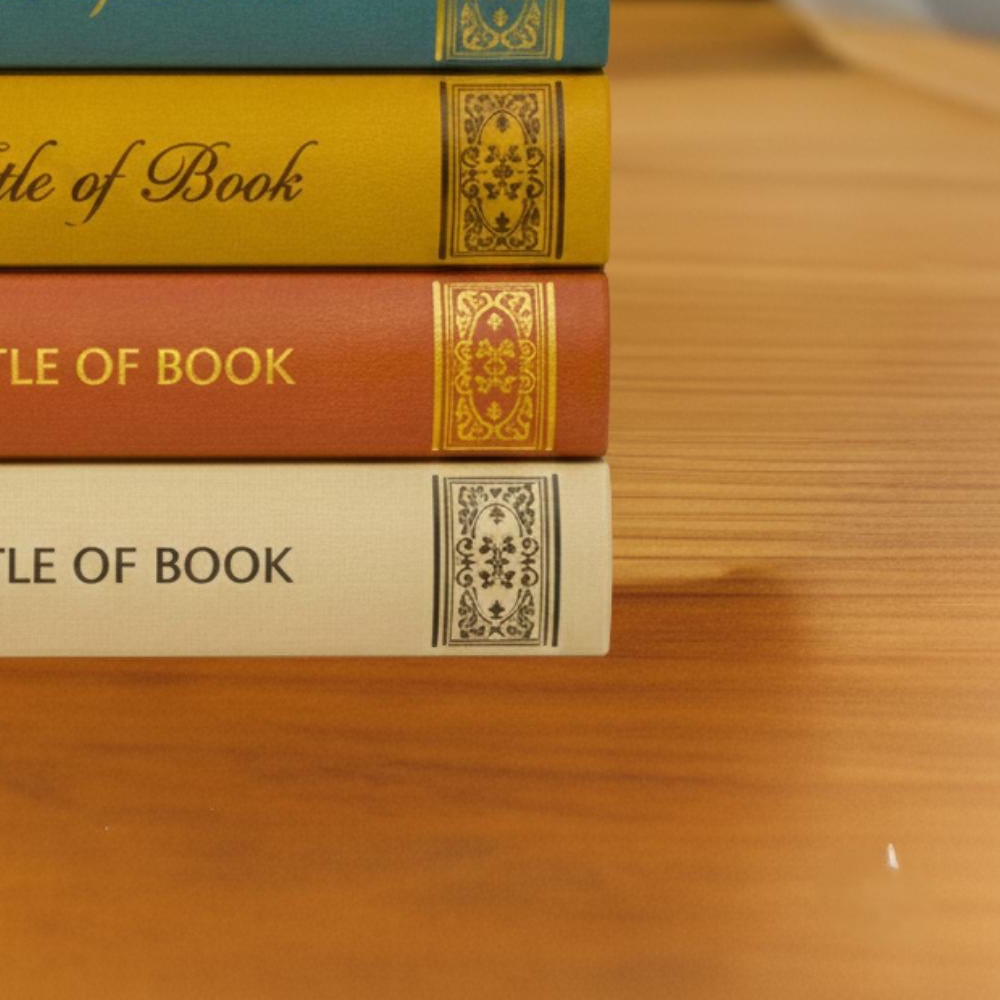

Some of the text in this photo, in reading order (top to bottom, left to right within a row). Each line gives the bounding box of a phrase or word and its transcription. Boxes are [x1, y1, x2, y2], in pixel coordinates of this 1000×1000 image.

[64, 140, 146, 227] of
[141, 140, 318, 203] Book
[75, 347, 140, 386] OF
[157, 347, 296, 386] BOOK
[73, 546, 136, 584] OF
[155, 546, 293, 584] BOOK
